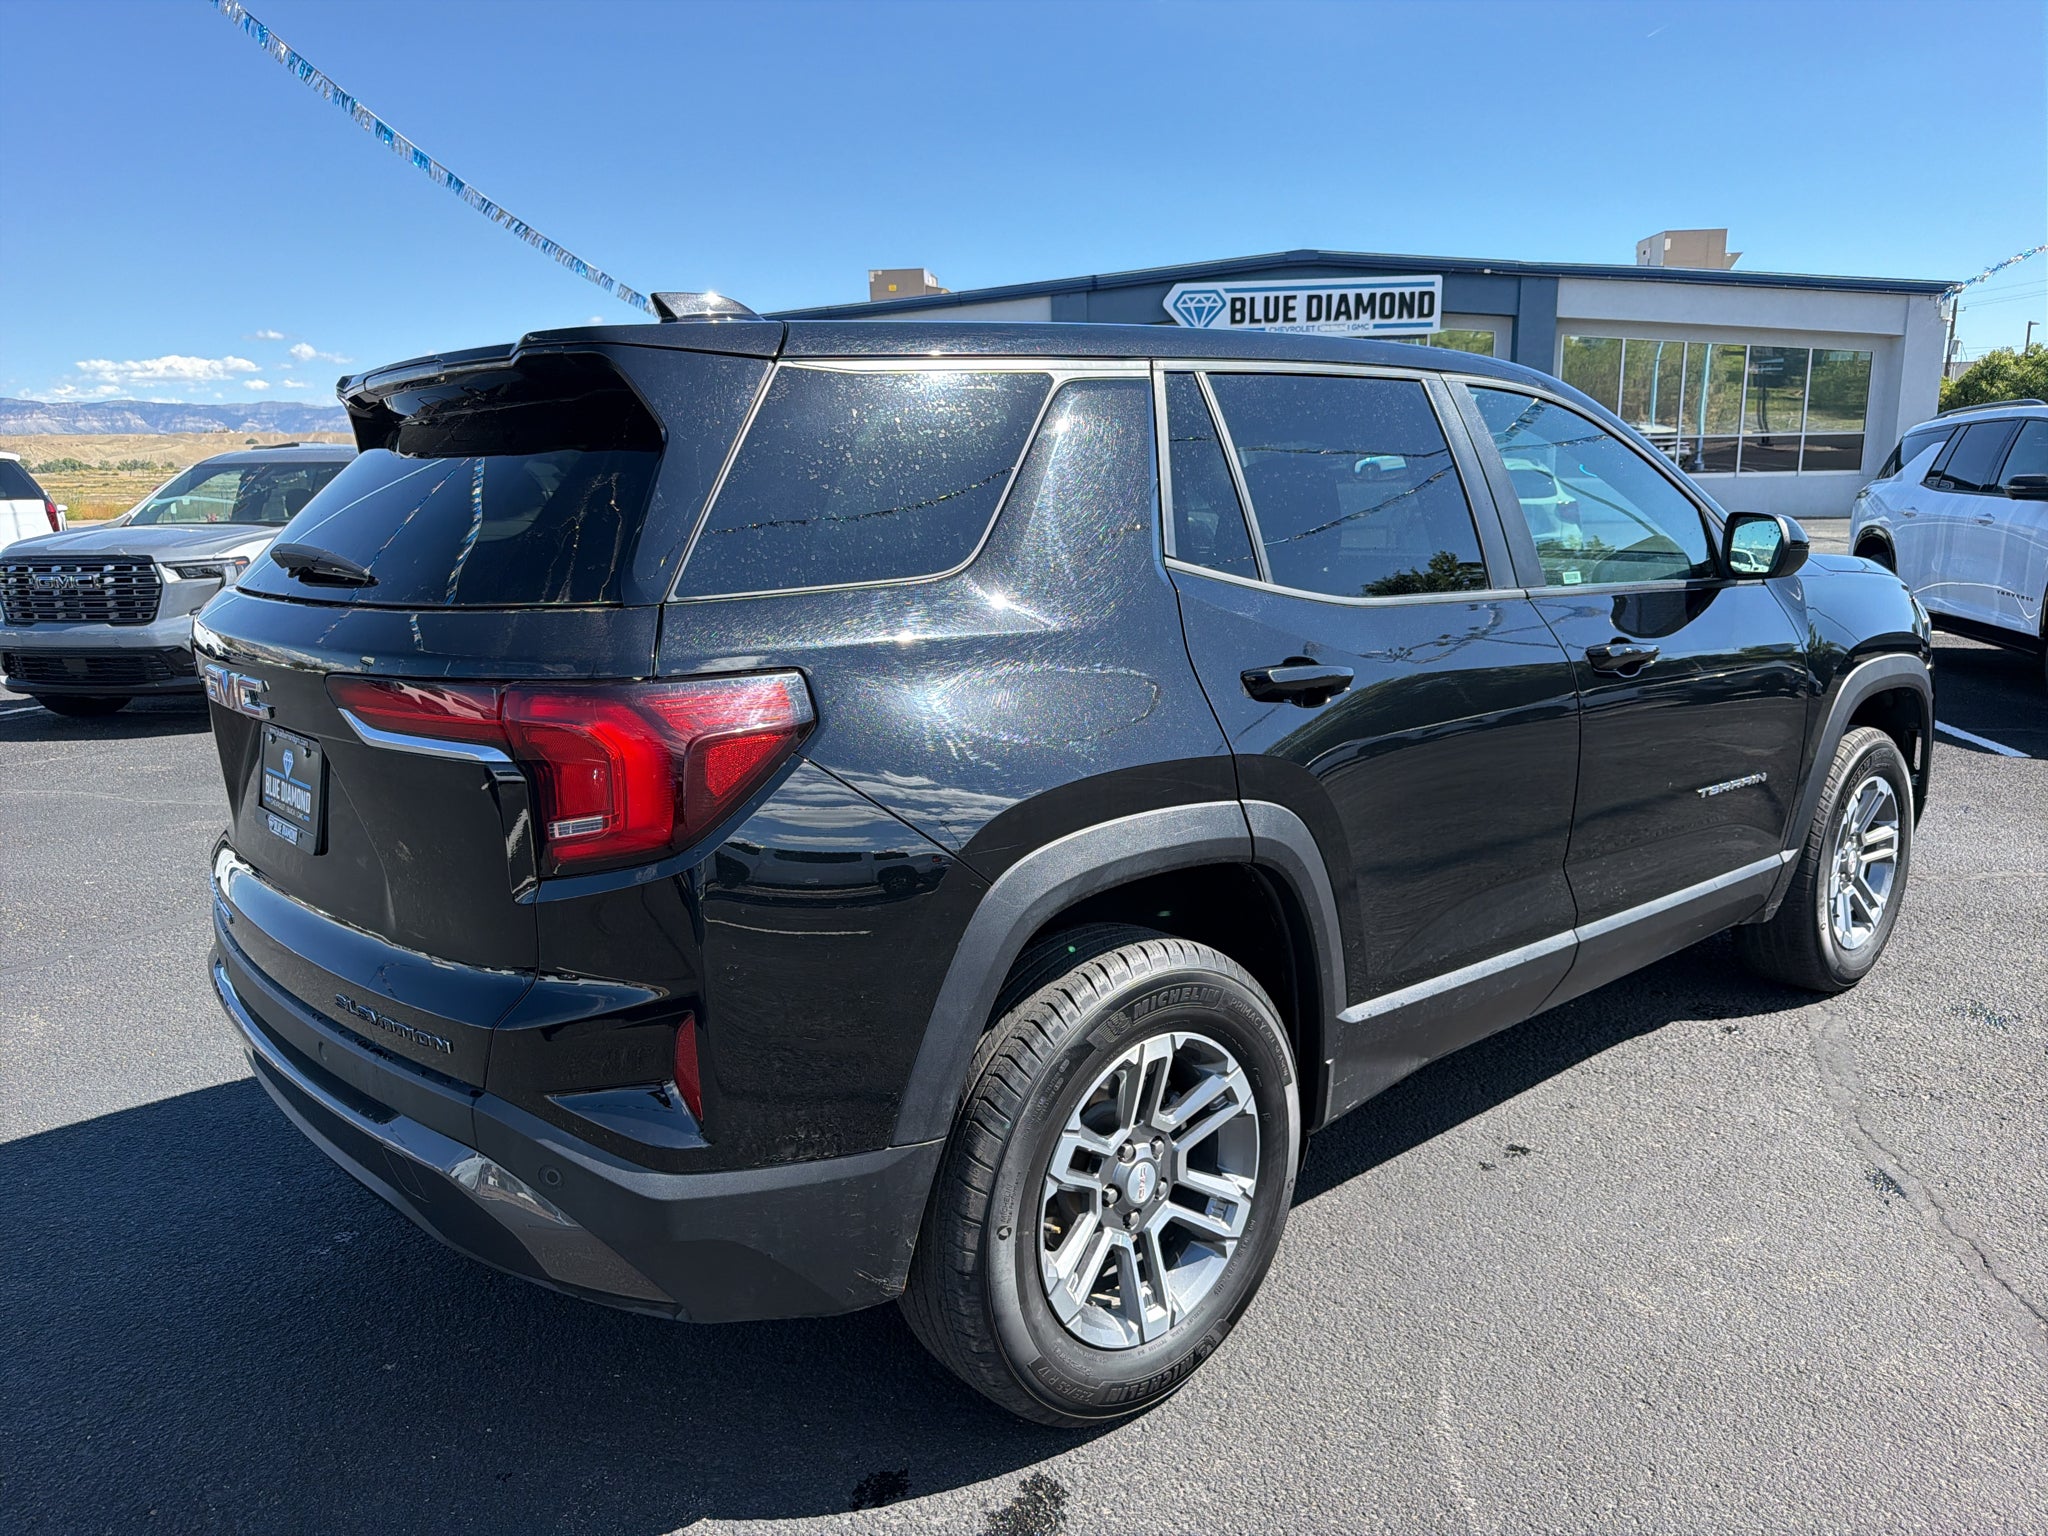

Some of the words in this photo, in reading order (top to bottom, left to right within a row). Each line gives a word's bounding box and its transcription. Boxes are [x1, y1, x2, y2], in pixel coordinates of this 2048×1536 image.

[1230, 295, 1297, 325] BLUE
[1306, 290, 1435, 321] DIAMOND
[1352, 323, 1369, 331] GMC
[35, 574, 97, 589] GMC
[204, 663, 275, 719] GMC
[265, 774, 280, 800] BLUE
[280, 780, 311, 814] DIAMOND
[1696, 772, 1767, 798] TERRAIN
[335, 993, 454, 1054] ELEVATION
[1133, 987, 1220, 1018] MICHELIN
[1229, 996, 1266, 1031] PRIMACY
[1000, 1183, 1013, 1223] MICHELIN
[1037, 1365, 1050, 1378] 17
[1108, 1353, 1195, 1401] MICHELIN
